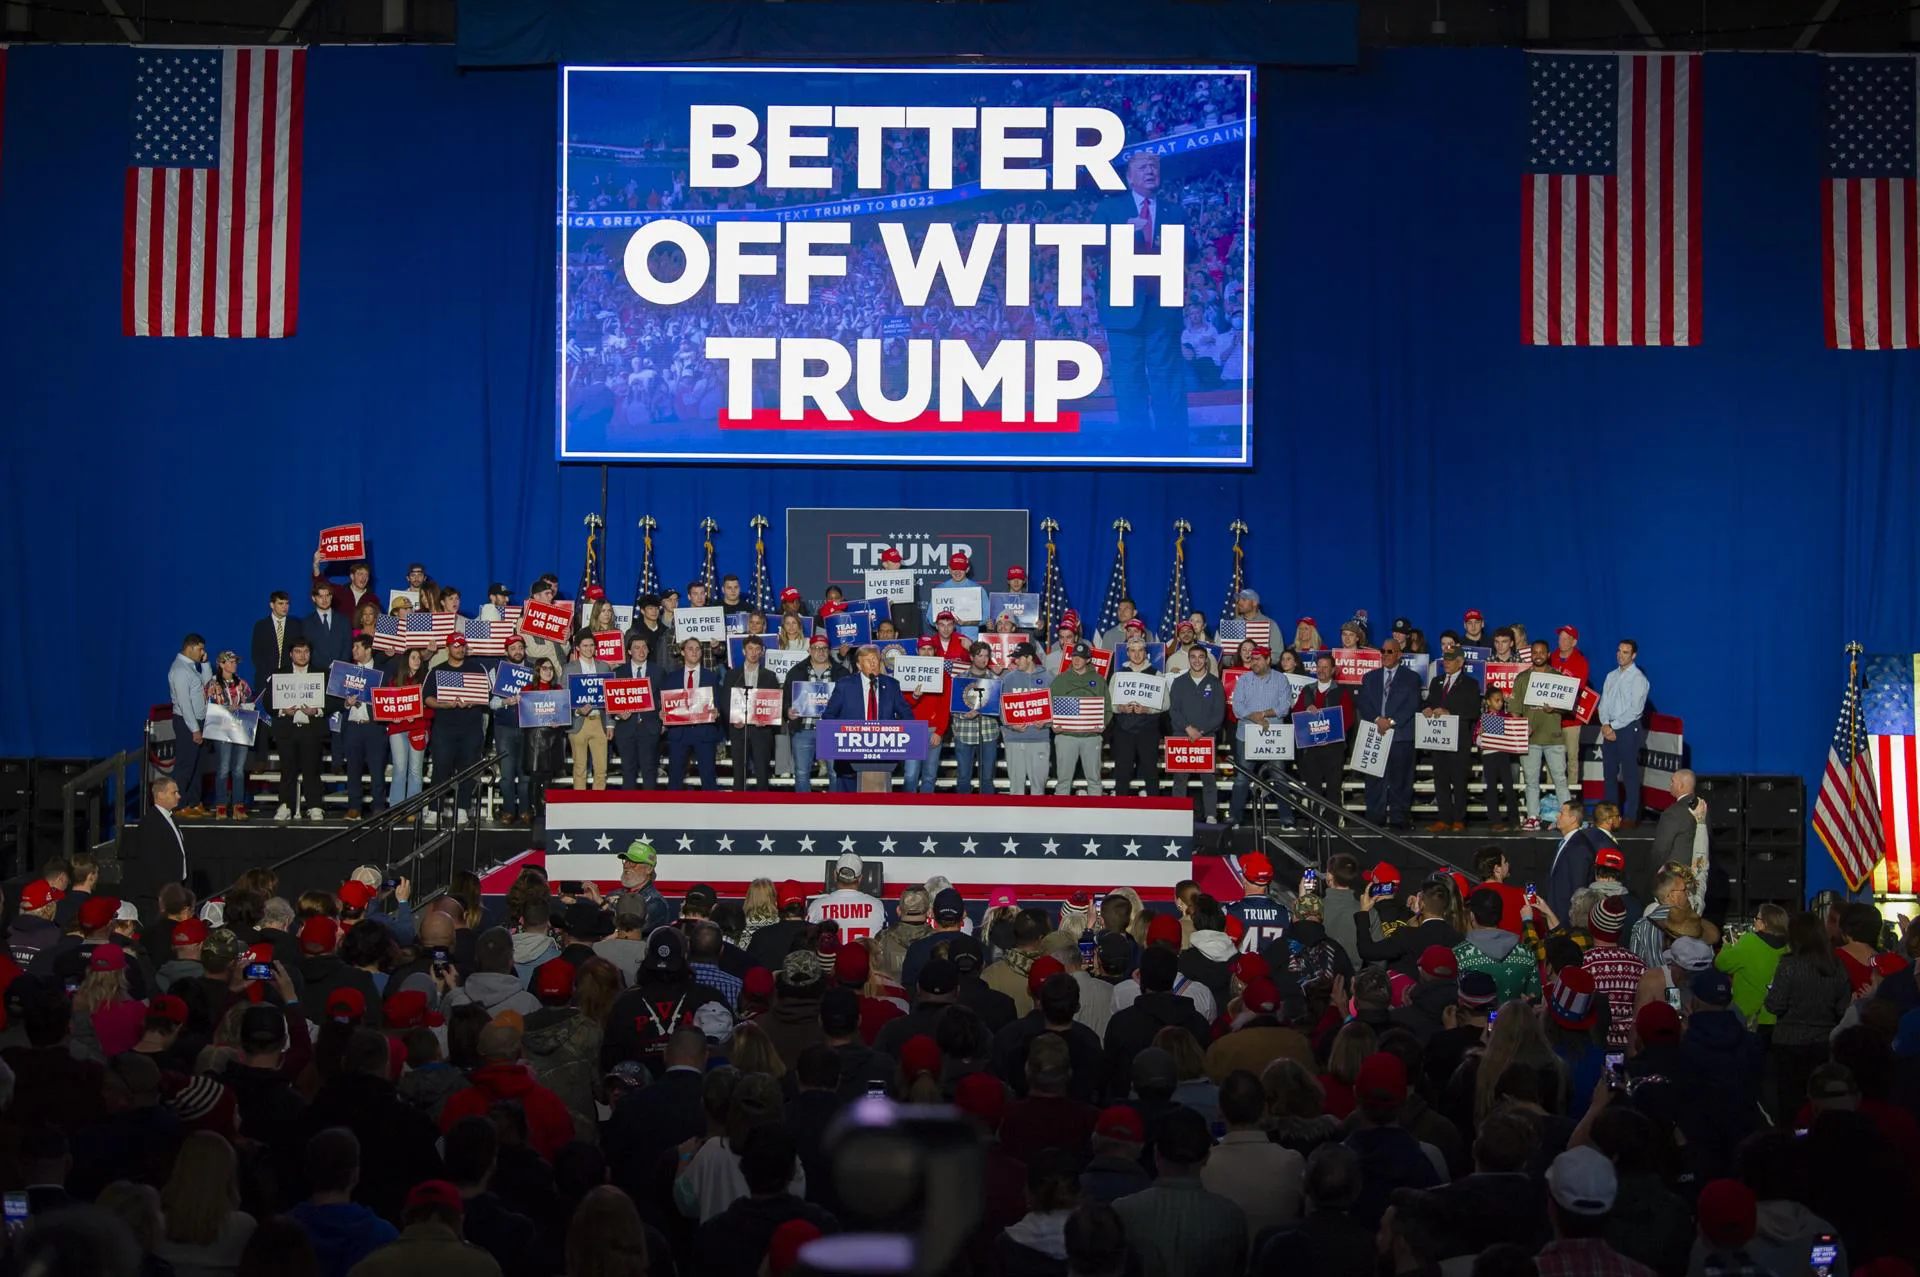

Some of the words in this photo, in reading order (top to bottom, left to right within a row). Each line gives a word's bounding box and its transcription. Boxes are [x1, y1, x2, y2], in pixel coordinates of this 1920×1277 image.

[689, 104, 1127, 191] BETTER
[776, 210, 811, 222] TEXT
[815, 204, 862, 217] TRUMP
[866, 201, 885, 211] TO
[891, 196, 935, 209] 88022
[603, 215, 652, 226] GREAT
[623, 218, 852, 306] OFF
[878, 222, 1185, 308] WITH
[704, 336, 1104, 424] TRUMP
[322, 536, 338, 546] LIVE
[339, 534, 360, 543] FREE
[340, 543, 354, 552] DIE
[528, 608, 546, 620] LIVE
[547, 613, 569, 625] FREE
[678, 617, 697, 625] LIVE
[699, 616, 721, 624] FREE
[532, 619, 544, 628] OR
[546, 622, 560, 632] DIE
[598, 639, 621, 648] FREE
[768, 658, 788, 666] LIVE
[345, 674, 366, 685] TEAM
[580, 678, 604, 686] VOTE
[607, 688, 626, 696] LIVE
[626, 686, 649, 695] FREE
[1138, 682, 1162, 692] FREE
[1531, 681, 1550, 690] LIVE
[1552, 684, 1574, 694] FREE
[396, 694, 420, 703] FREE
[1138, 690, 1153, 699] DIE
[1550, 692, 1566, 700] DIE
[398, 704, 412, 712] DIE
[665, 698, 686, 708] LIVE
[1005, 700, 1024, 710] LIVE
[1026, 698, 1048, 708] FREE
[756, 708, 771, 716] DIE
[1012, 708, 1026, 717] OR
[1028, 708, 1043, 716] DIE
[1308, 720, 1330, 728] TEAM
[834, 732, 911, 748] TRUMP
[1366, 726, 1376, 747] FREE
[1168, 747, 1187, 755] LIVE
[1189, 747, 1212, 755] FREE
[1361, 748, 1372, 768] LIVE
[1370, 751, 1379, 764] OR
[822, 904, 873, 920] TRUMP
[1244, 908, 1278, 920] TRUMP
